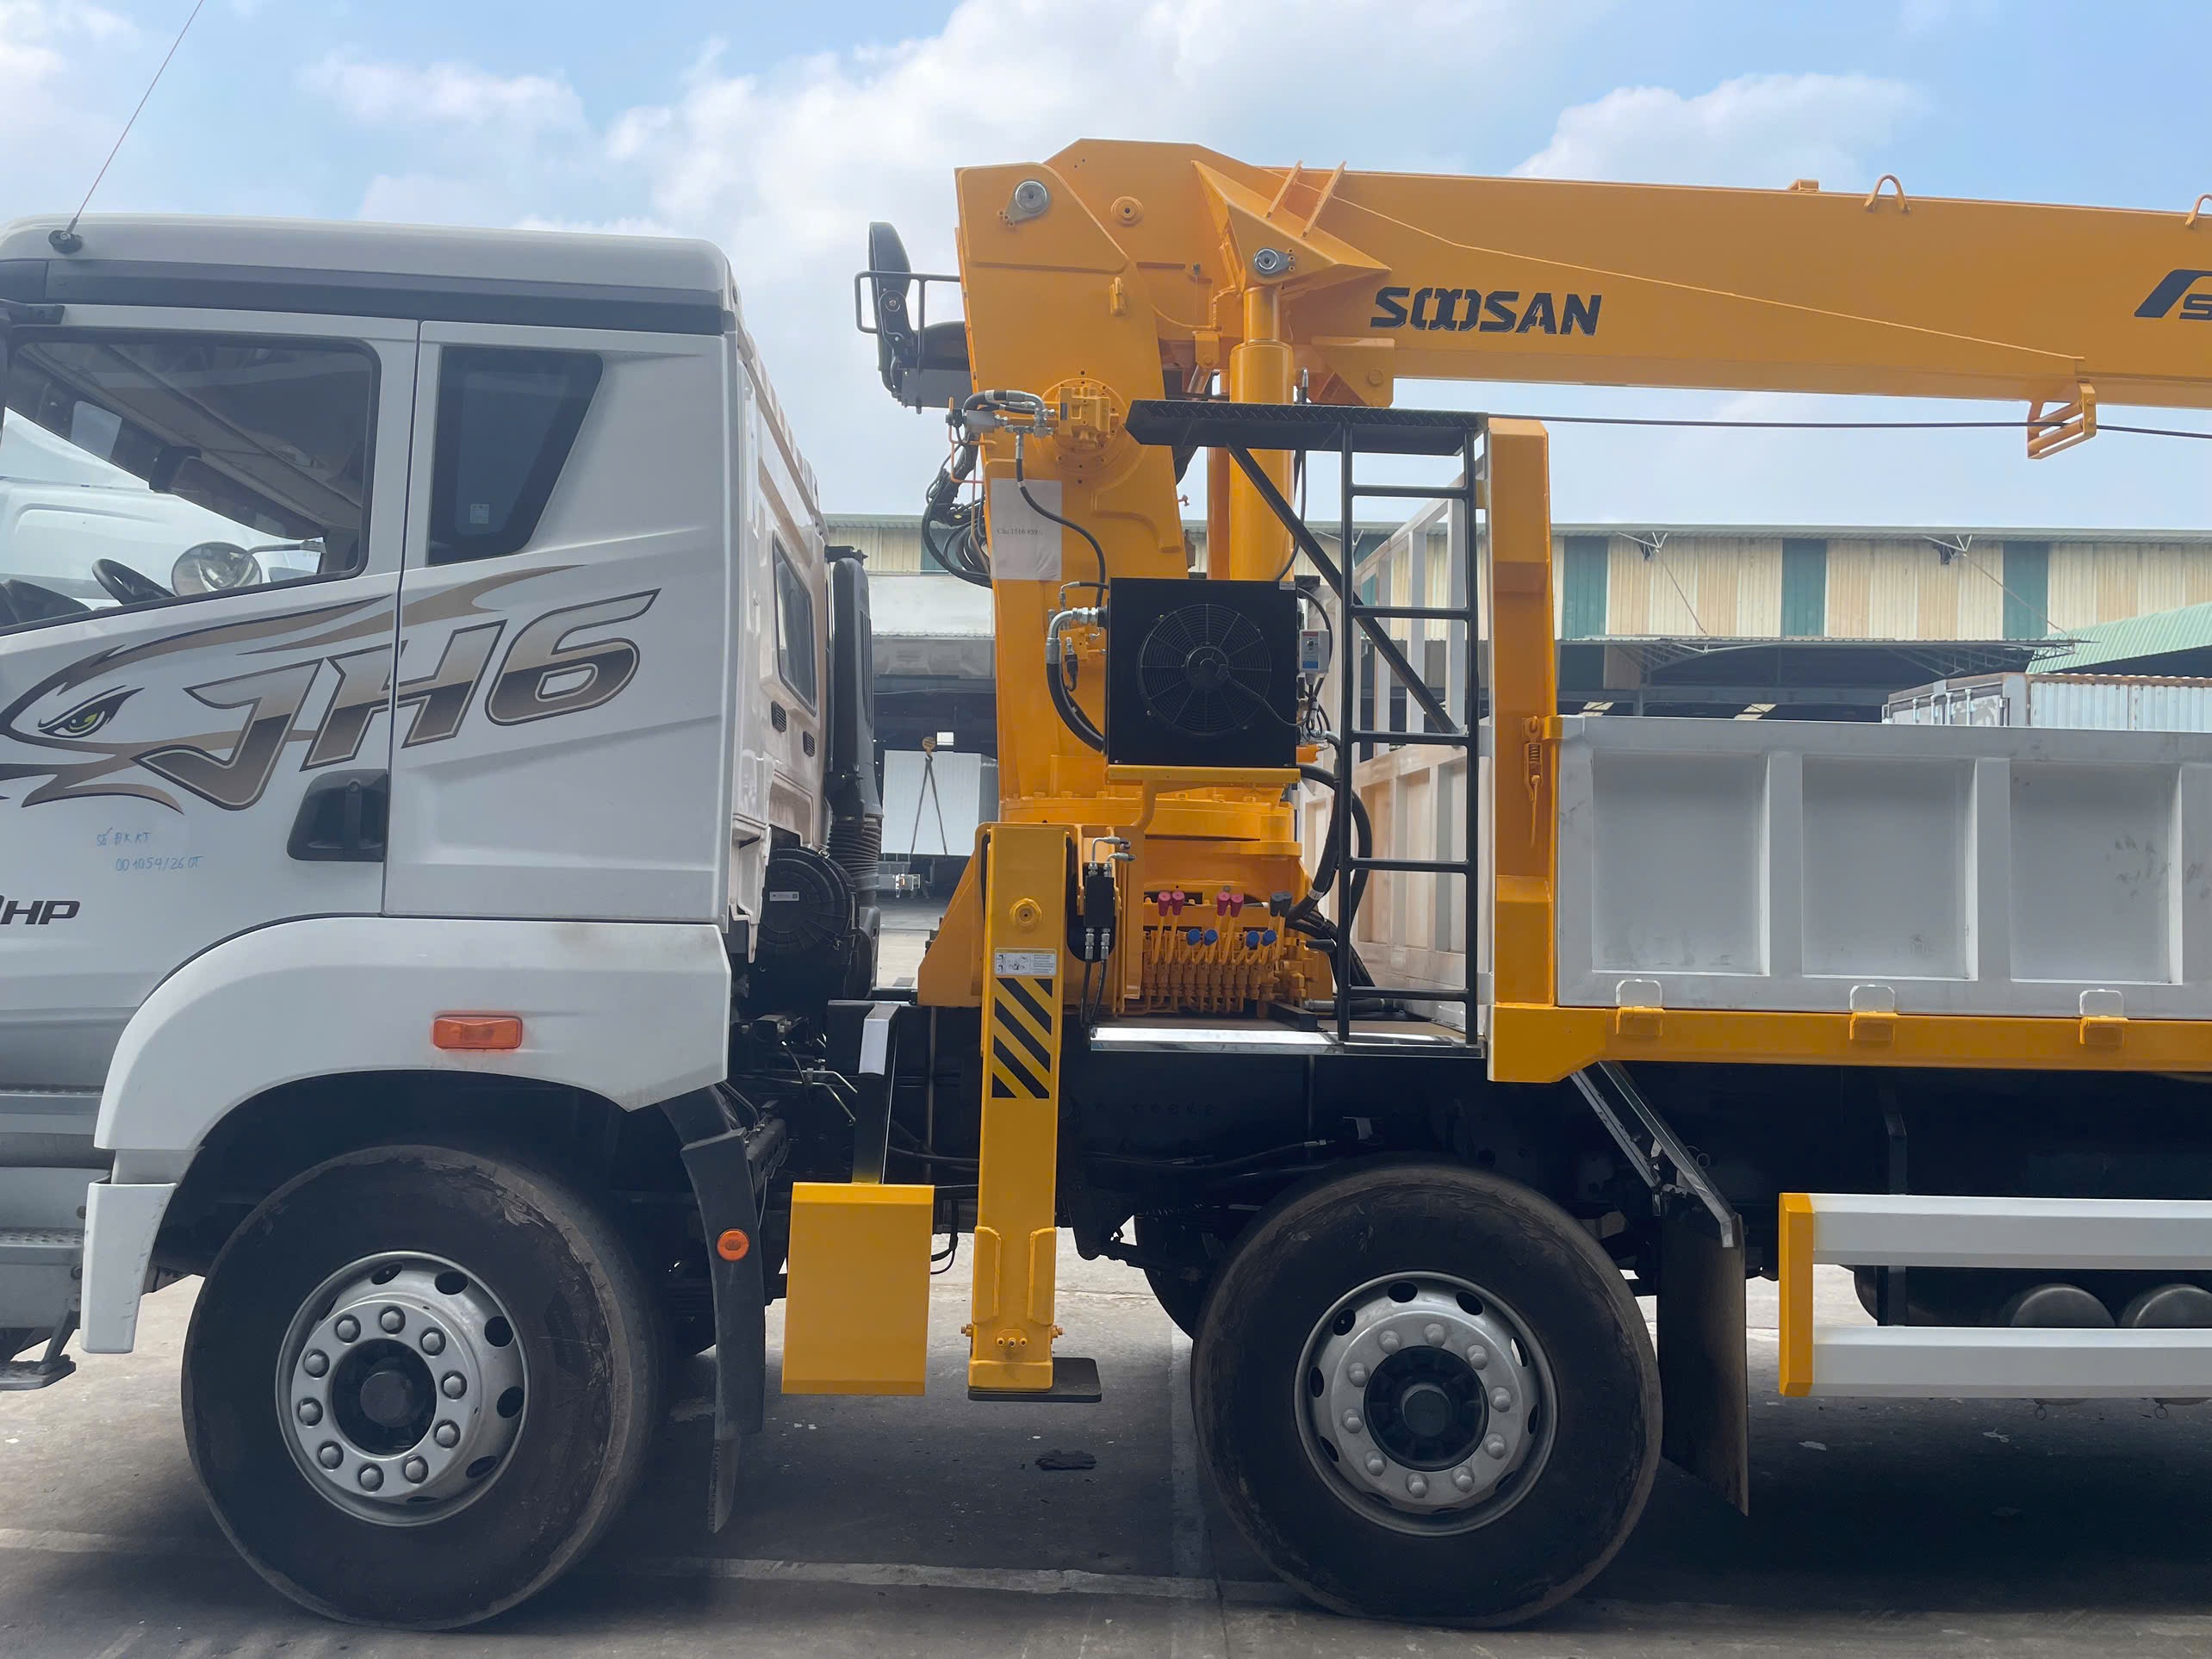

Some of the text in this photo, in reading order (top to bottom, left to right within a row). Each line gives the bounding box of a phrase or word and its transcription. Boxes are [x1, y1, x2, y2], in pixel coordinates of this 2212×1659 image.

[1370, 286, 1602, 337] SOOSAN
[130, 587, 662, 811] JH6
[0, 894, 81, 925] HP
